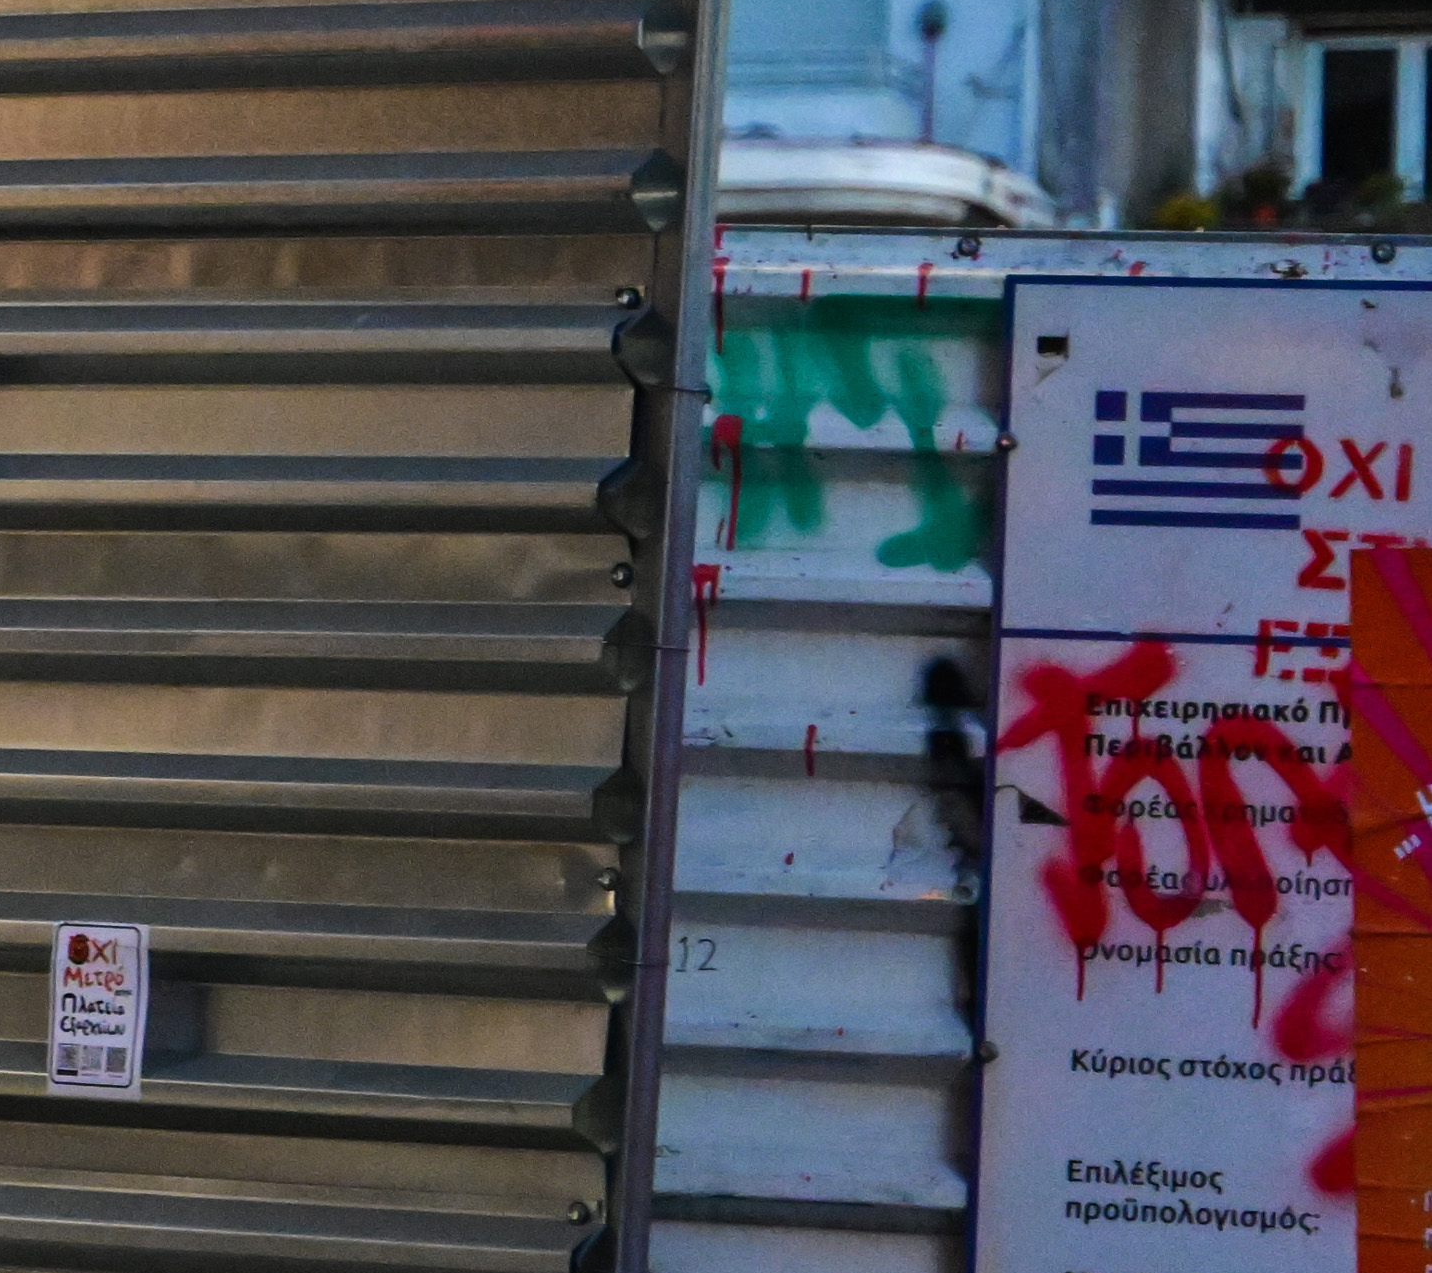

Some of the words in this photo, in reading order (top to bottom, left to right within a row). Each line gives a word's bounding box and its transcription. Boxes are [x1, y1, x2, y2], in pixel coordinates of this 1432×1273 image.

[1086, 693, 1310, 724] Επιχειρησιακό
[675, 936, 718, 973] 12
[1070, 1048, 1171, 1079] Κύριος
[1179, 1055, 1282, 1086] στόχος
[1066, 1159, 1224, 1194] Επιλέξιμος
